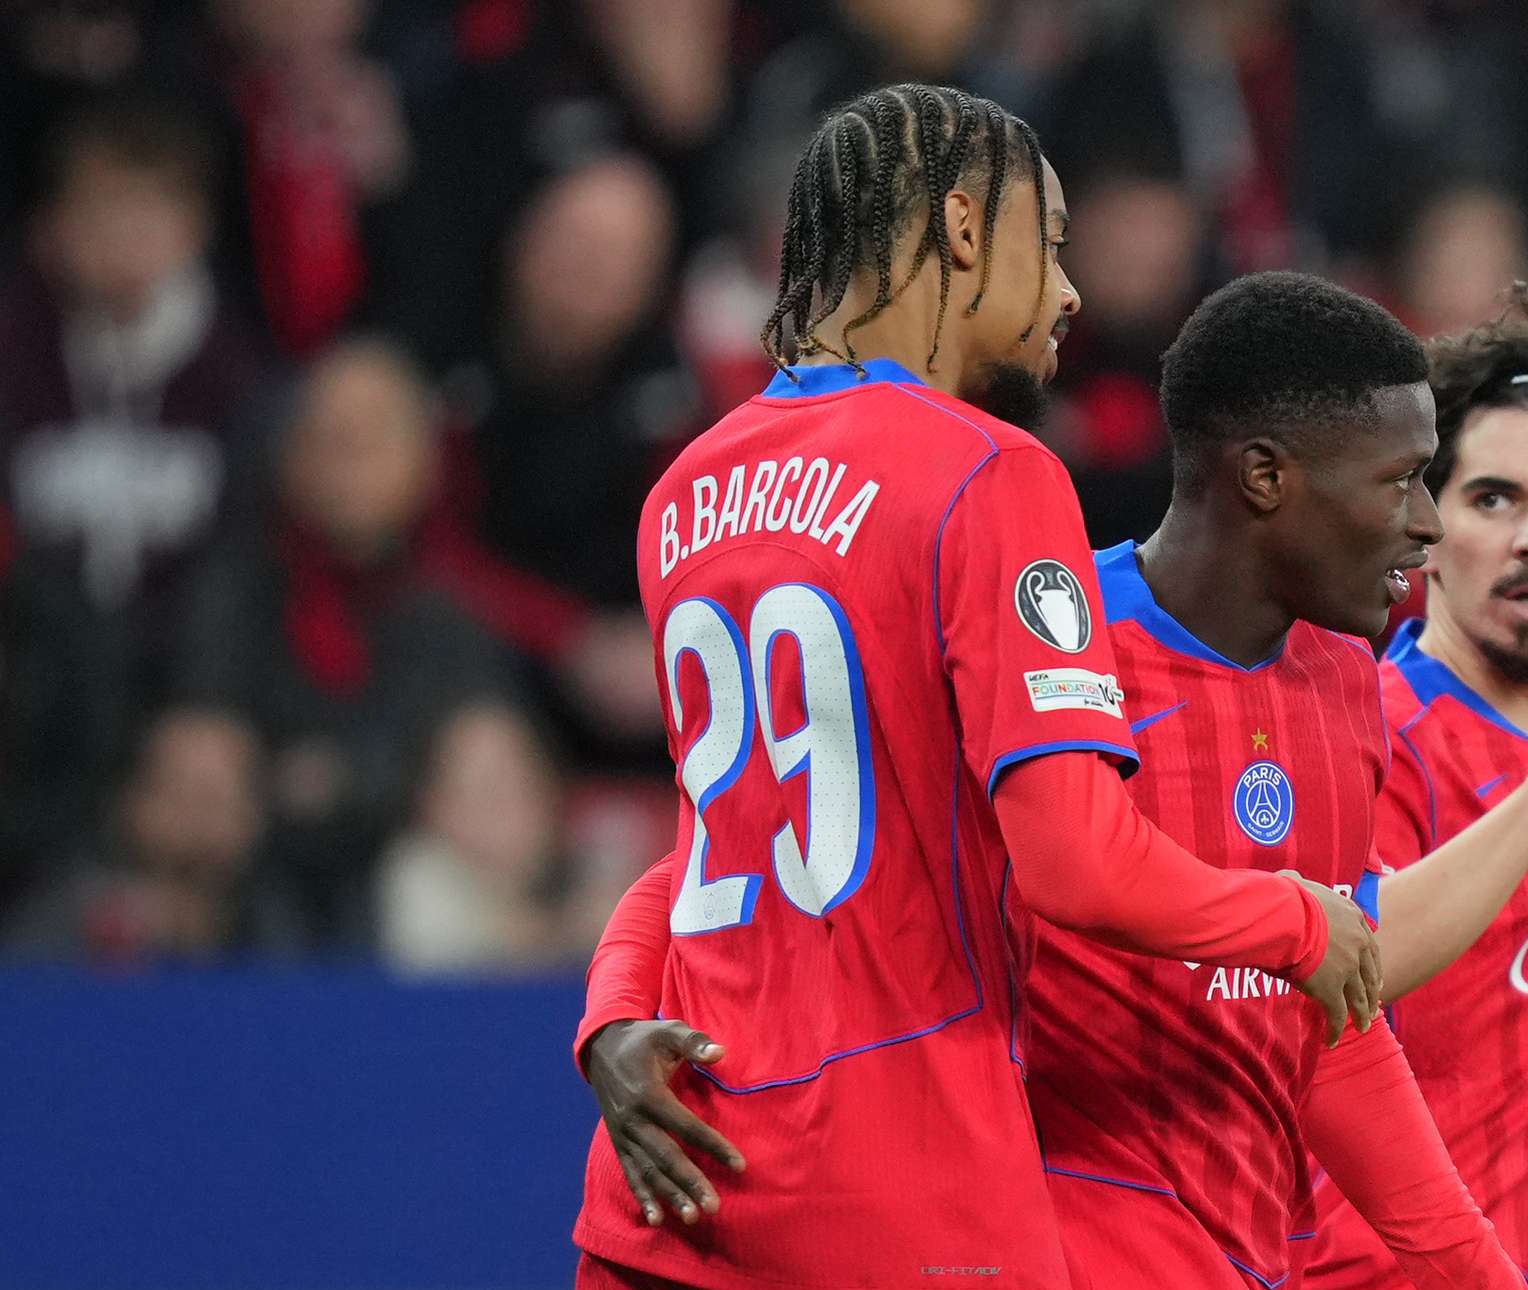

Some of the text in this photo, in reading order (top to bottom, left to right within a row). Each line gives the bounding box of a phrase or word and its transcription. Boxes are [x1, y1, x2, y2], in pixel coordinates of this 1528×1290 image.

[660, 456, 880, 580] B.BARCOLA
[662, 582, 877, 936] 29
[1243, 767, 1282, 788] PARIS
